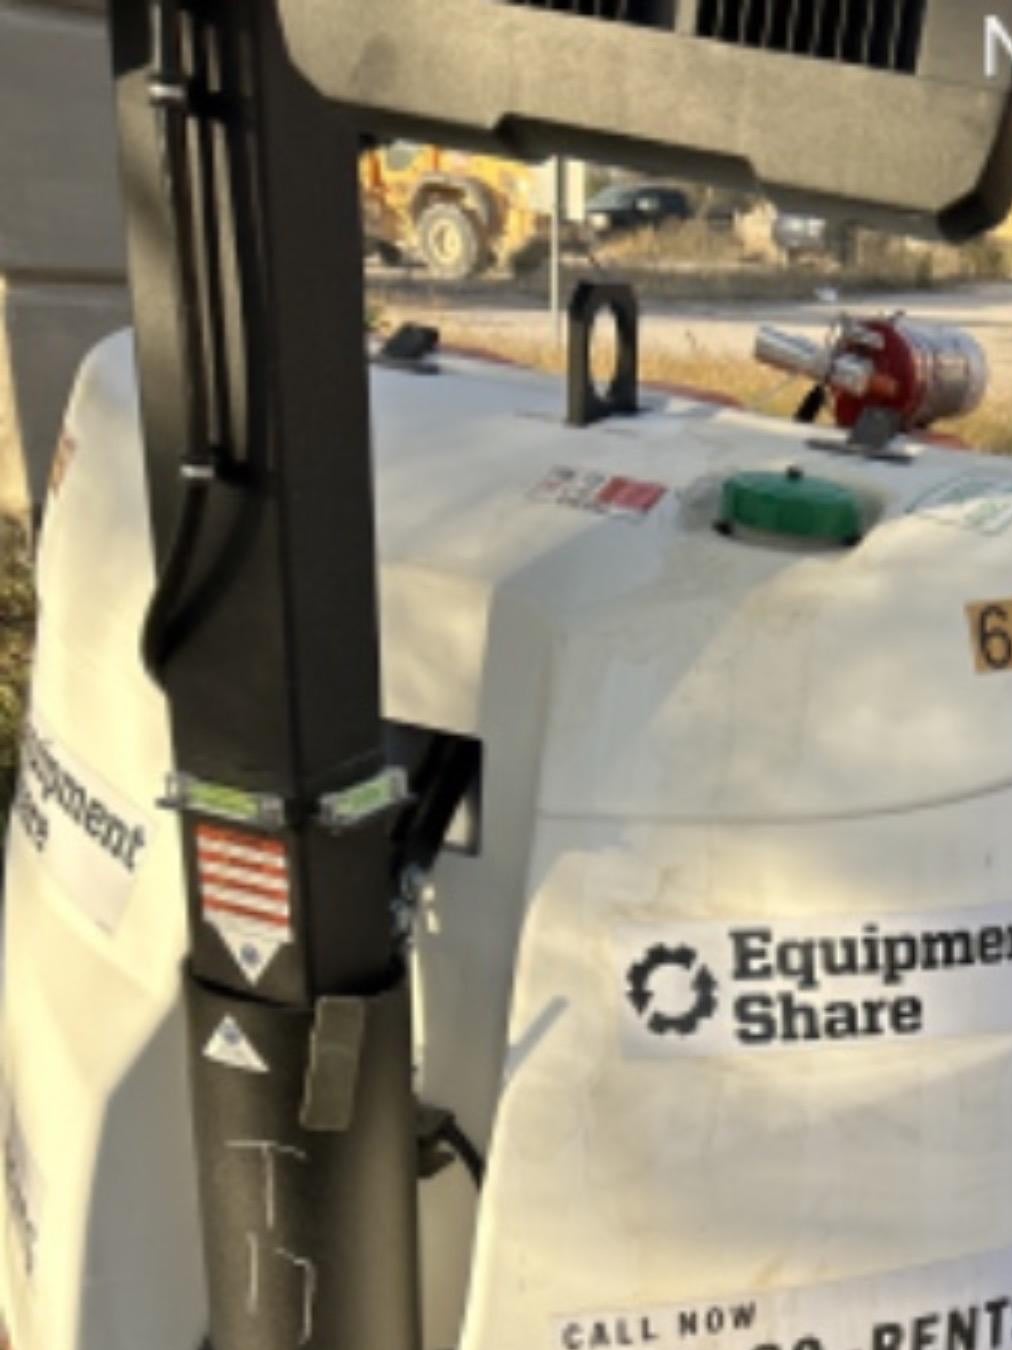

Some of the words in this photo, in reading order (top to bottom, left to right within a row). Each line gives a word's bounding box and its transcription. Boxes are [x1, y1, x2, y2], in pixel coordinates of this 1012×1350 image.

[733, 990, 923, 1044] Share
[561, 1317, 657, 1350] CALL
[678, 1301, 757, 1335] NOW
